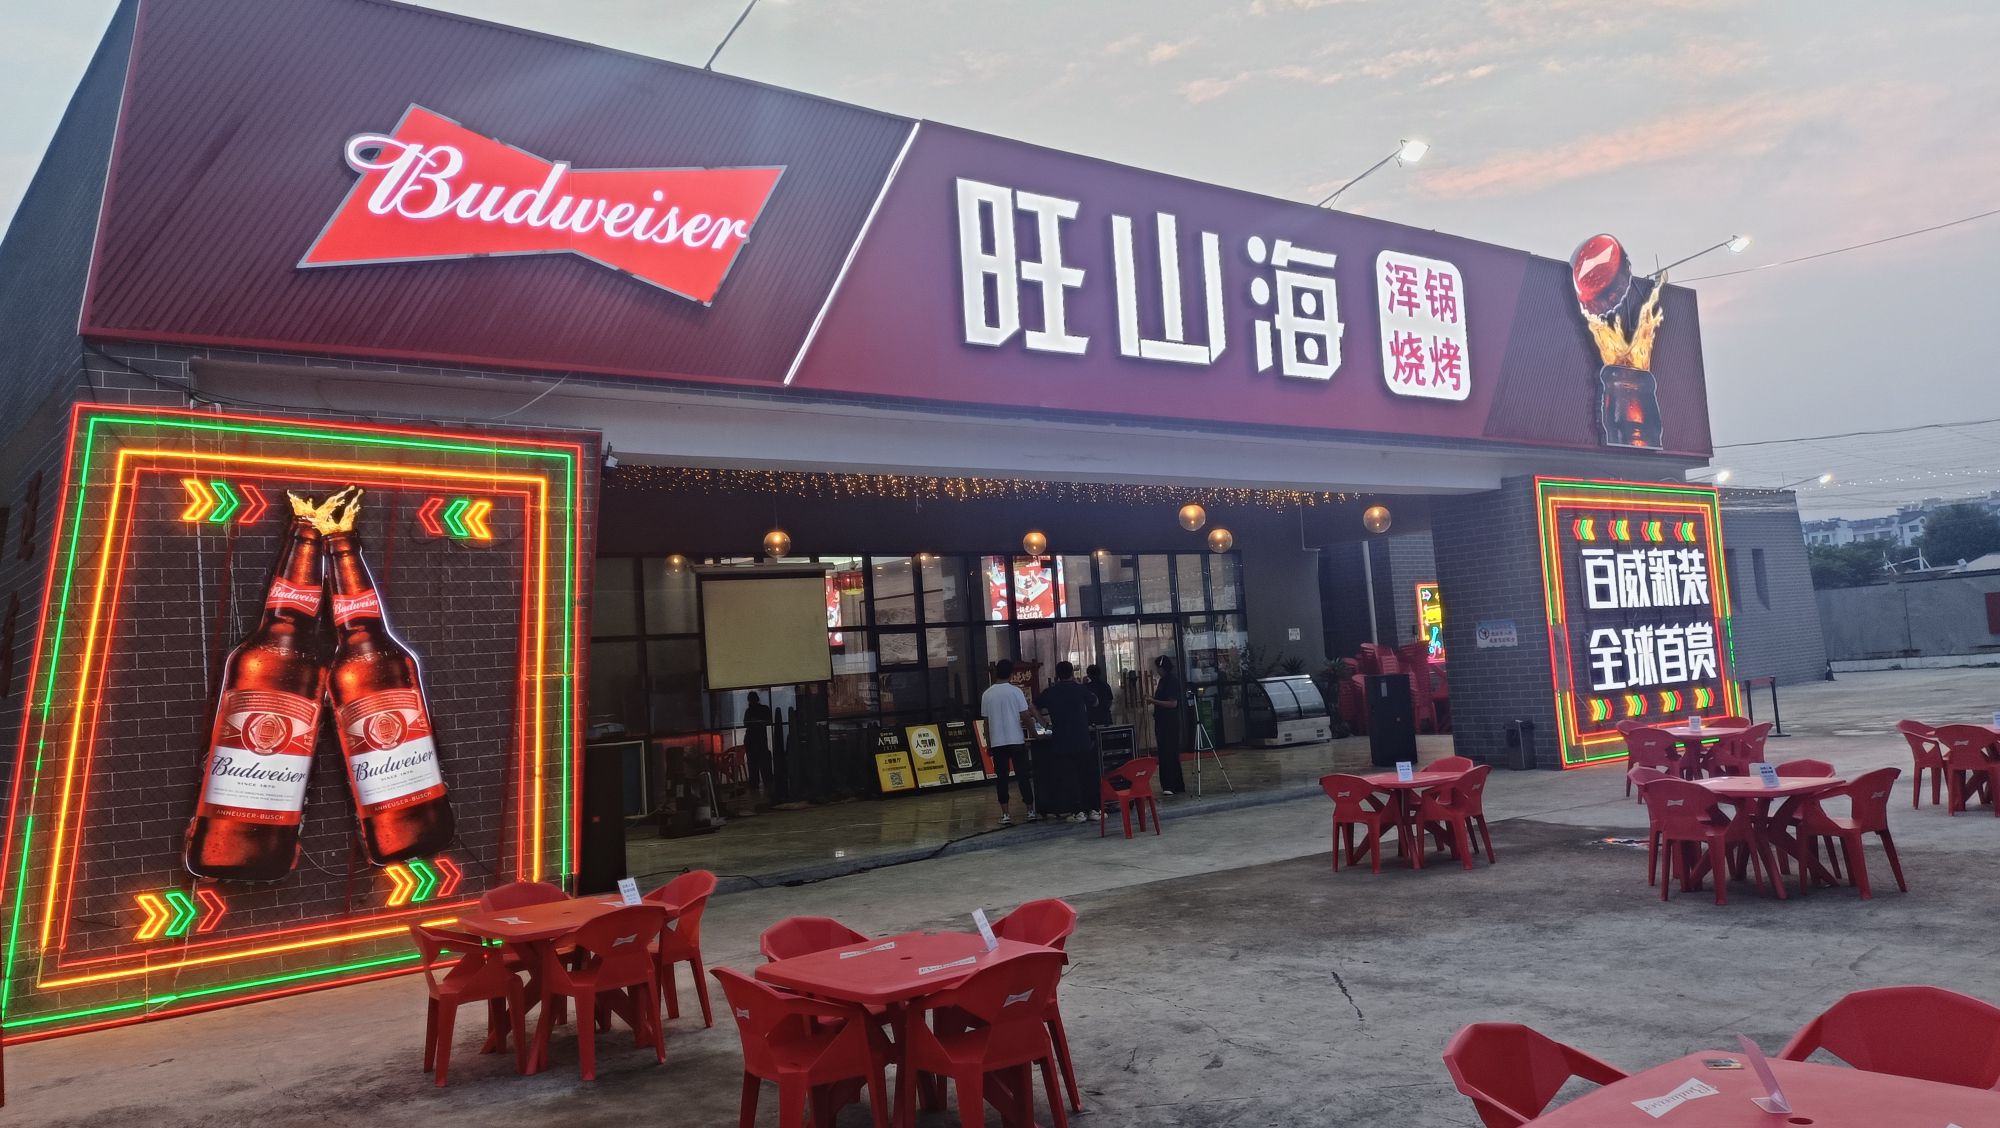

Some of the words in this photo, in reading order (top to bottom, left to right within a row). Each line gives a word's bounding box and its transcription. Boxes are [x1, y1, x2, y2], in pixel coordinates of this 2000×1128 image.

[347, 135, 747, 249] Budweiser
[956, 176, 1345, 381] 旺山海
[1385, 261, 1458, 324] 浑锅
[1389, 330, 1461, 391] 烧烤
[1581, 547, 1710, 609] 百威新装
[1589, 621, 1717, 691] 全球首赏
[211, 755, 305, 783] Budweiser
[352, 749, 434, 782] Budweiser
[216, 808, 285, 821] ANHEUSER-BUSCH
[374, 791, 433, 812] ANHEUSER-BUSCH
